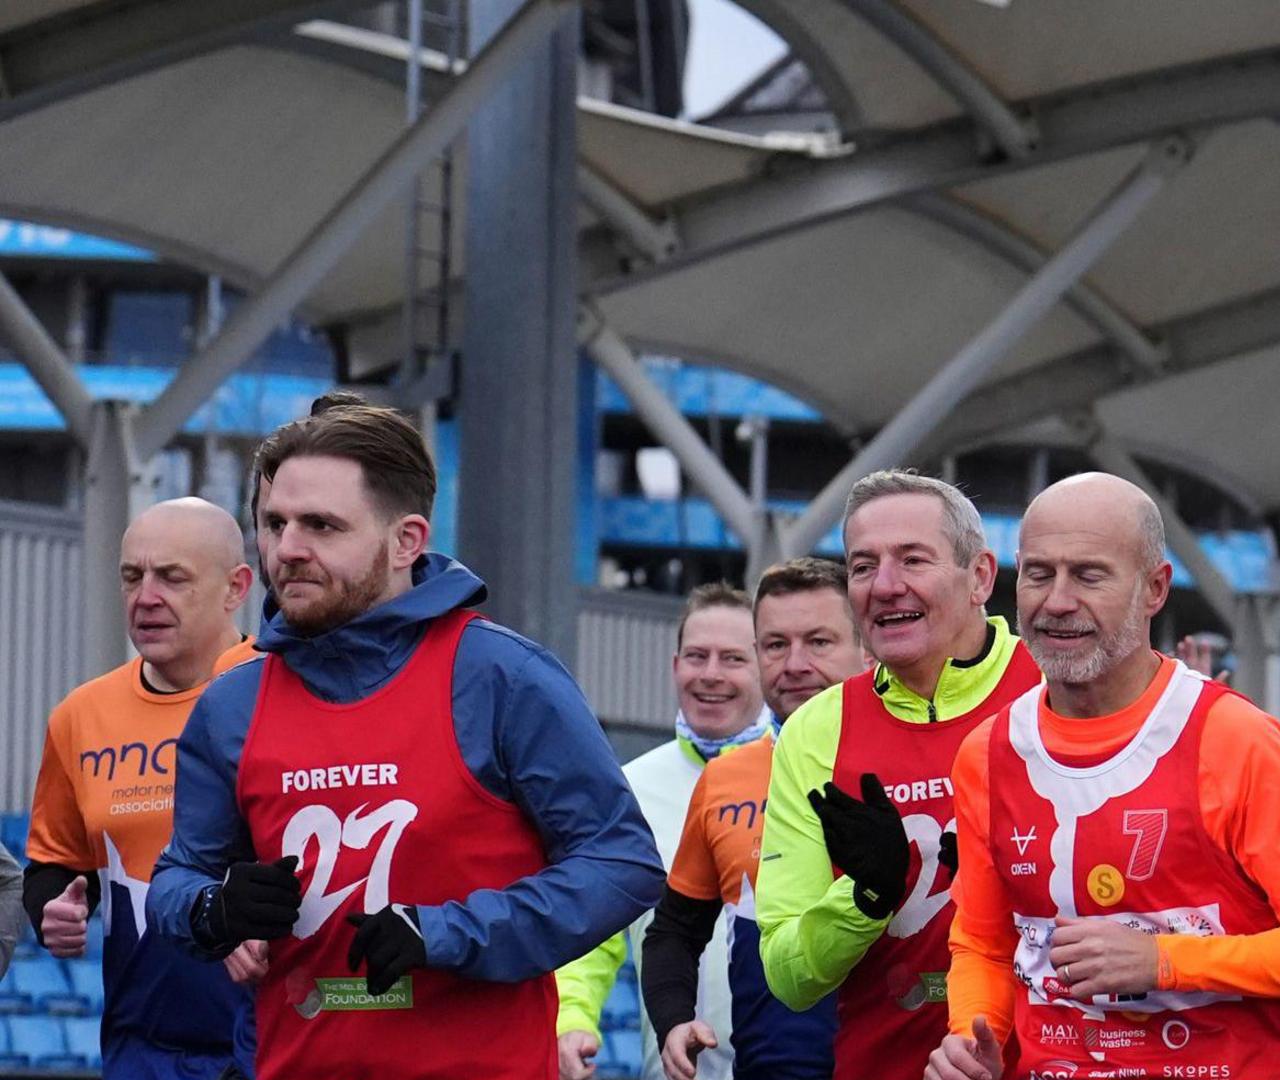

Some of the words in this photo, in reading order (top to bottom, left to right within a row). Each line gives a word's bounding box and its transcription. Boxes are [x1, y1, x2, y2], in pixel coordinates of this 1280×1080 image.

[281, 763, 399, 794] FOREVER
[1122, 808, 1168, 881] 7
[1010, 862, 1037, 875] OXEN
[1100, 1029, 1146, 1039] business
[1100, 1039, 1131, 1048] waste
[1163, 1065, 1230, 1078] SKOPES
